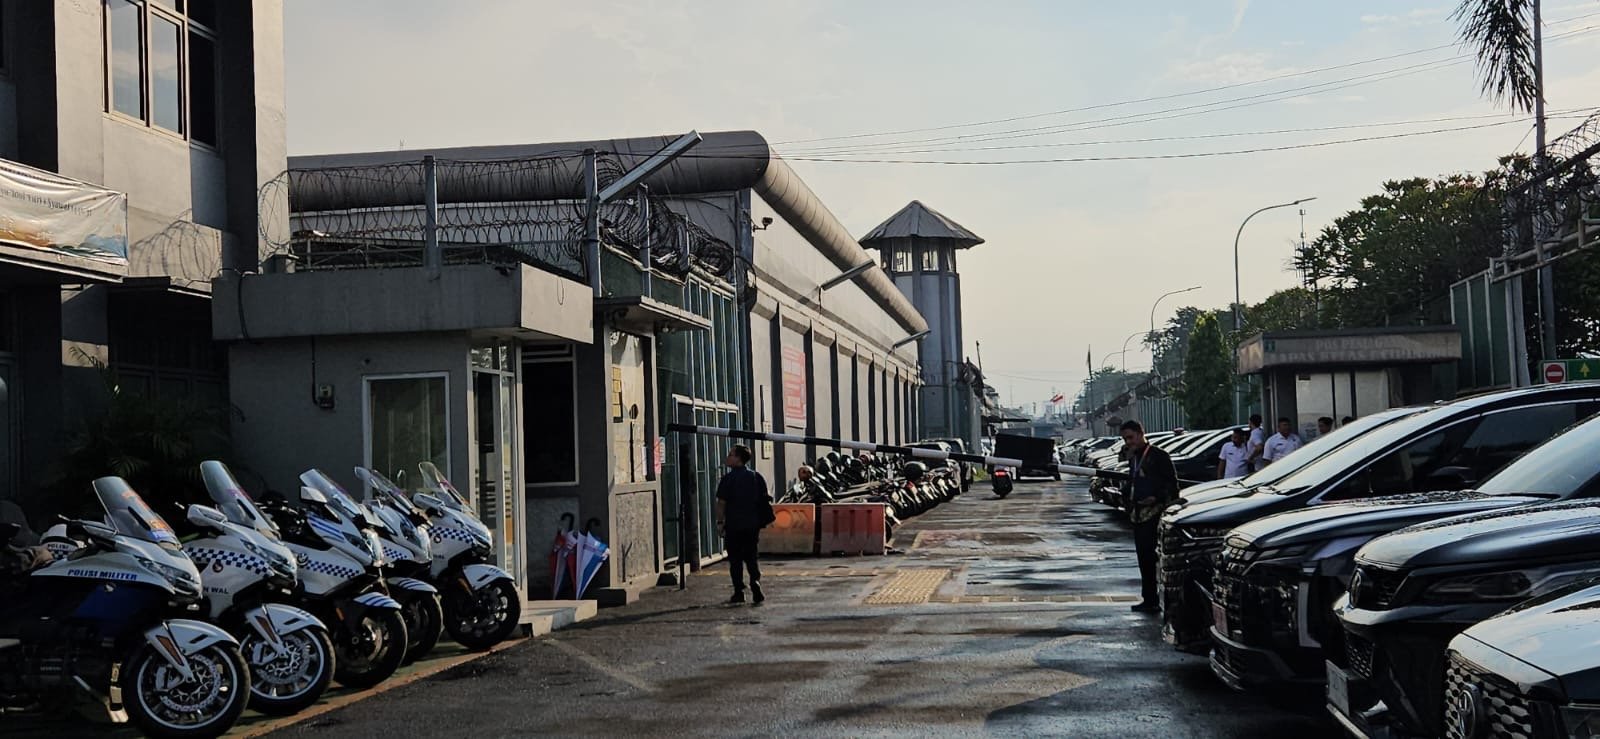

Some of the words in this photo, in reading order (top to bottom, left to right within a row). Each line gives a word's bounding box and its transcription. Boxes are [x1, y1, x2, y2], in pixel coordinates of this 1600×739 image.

[67, 569, 98, 578] POLISI
[100, 571, 138, 581] MILITER
[211, 586, 229, 595] WAL
